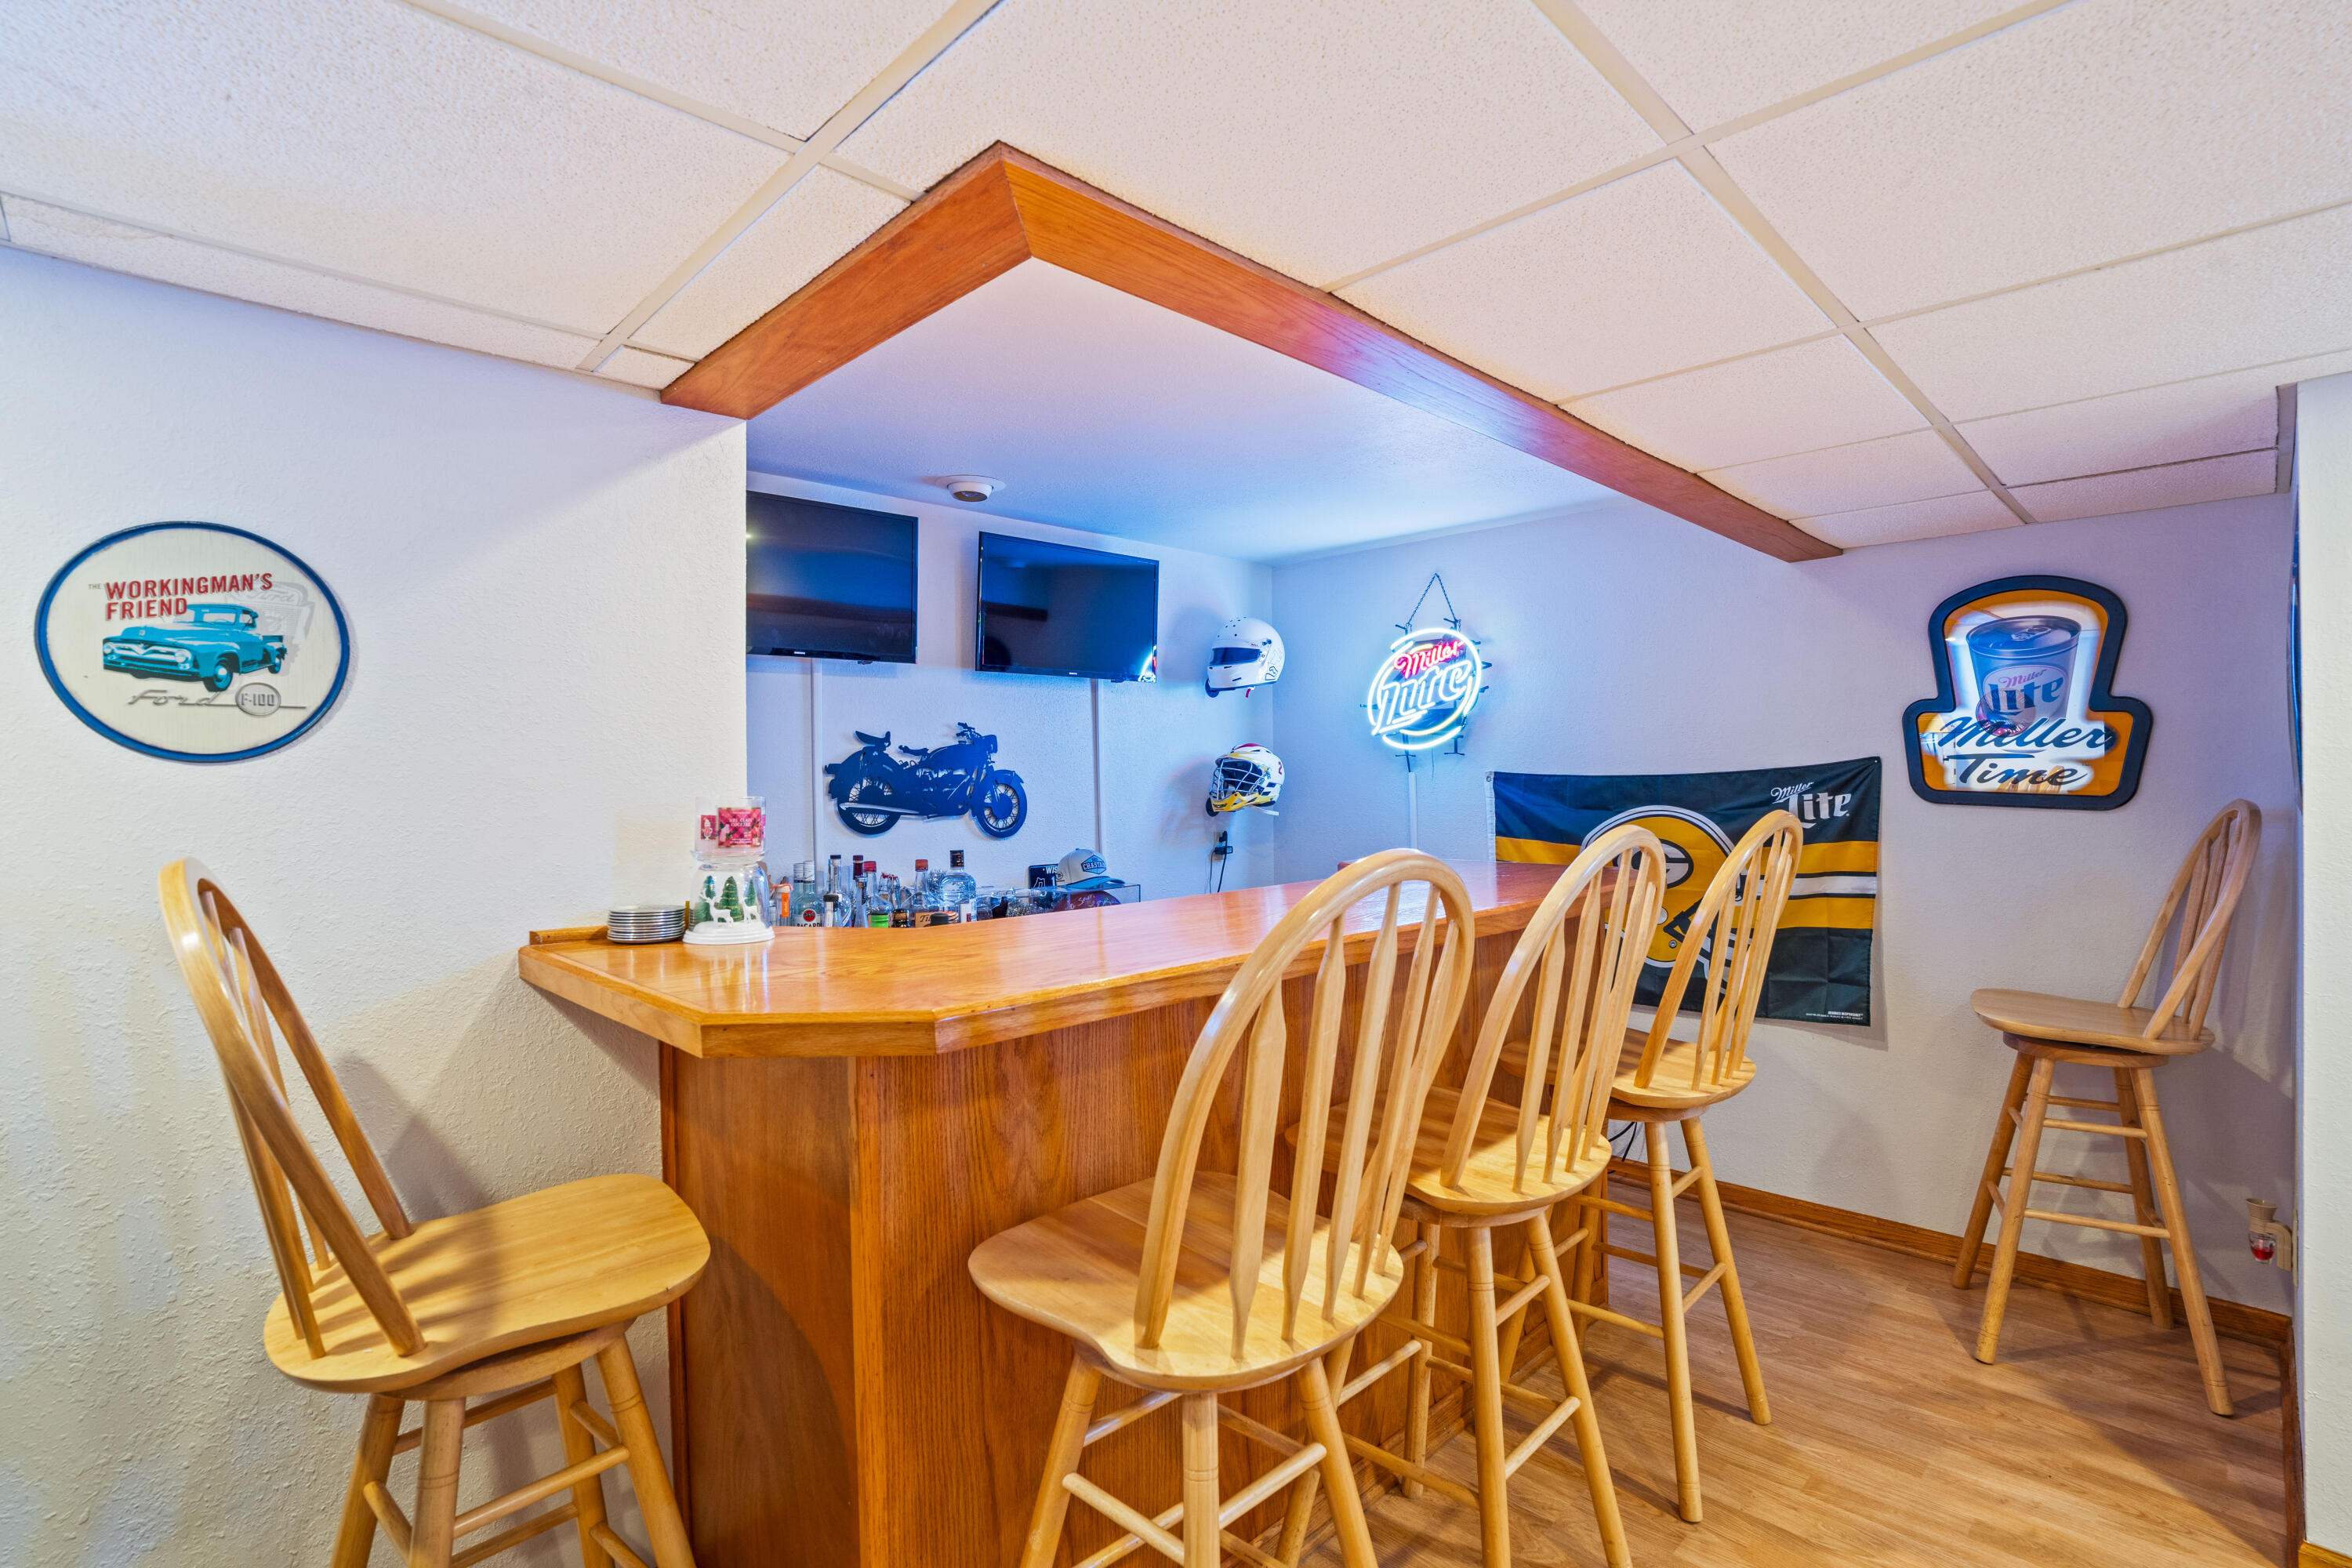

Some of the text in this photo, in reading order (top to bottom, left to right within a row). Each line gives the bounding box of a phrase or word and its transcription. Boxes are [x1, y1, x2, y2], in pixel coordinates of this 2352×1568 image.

[104, 572, 273, 600] WORKINGMAN'S
[106, 597, 188, 621] FRIEND
[1394, 640, 1465, 679] Miller
[1998, 669, 2048, 688] Miller
[128, 689, 221, 706] Ford
[241, 692, 276, 706] F-100
[1938, 717, 2114, 749] Miller
[1947, 753, 2089, 786] Time
[1770, 781, 1815, 804] Miller
[1788, 792, 1852, 829] Lite
